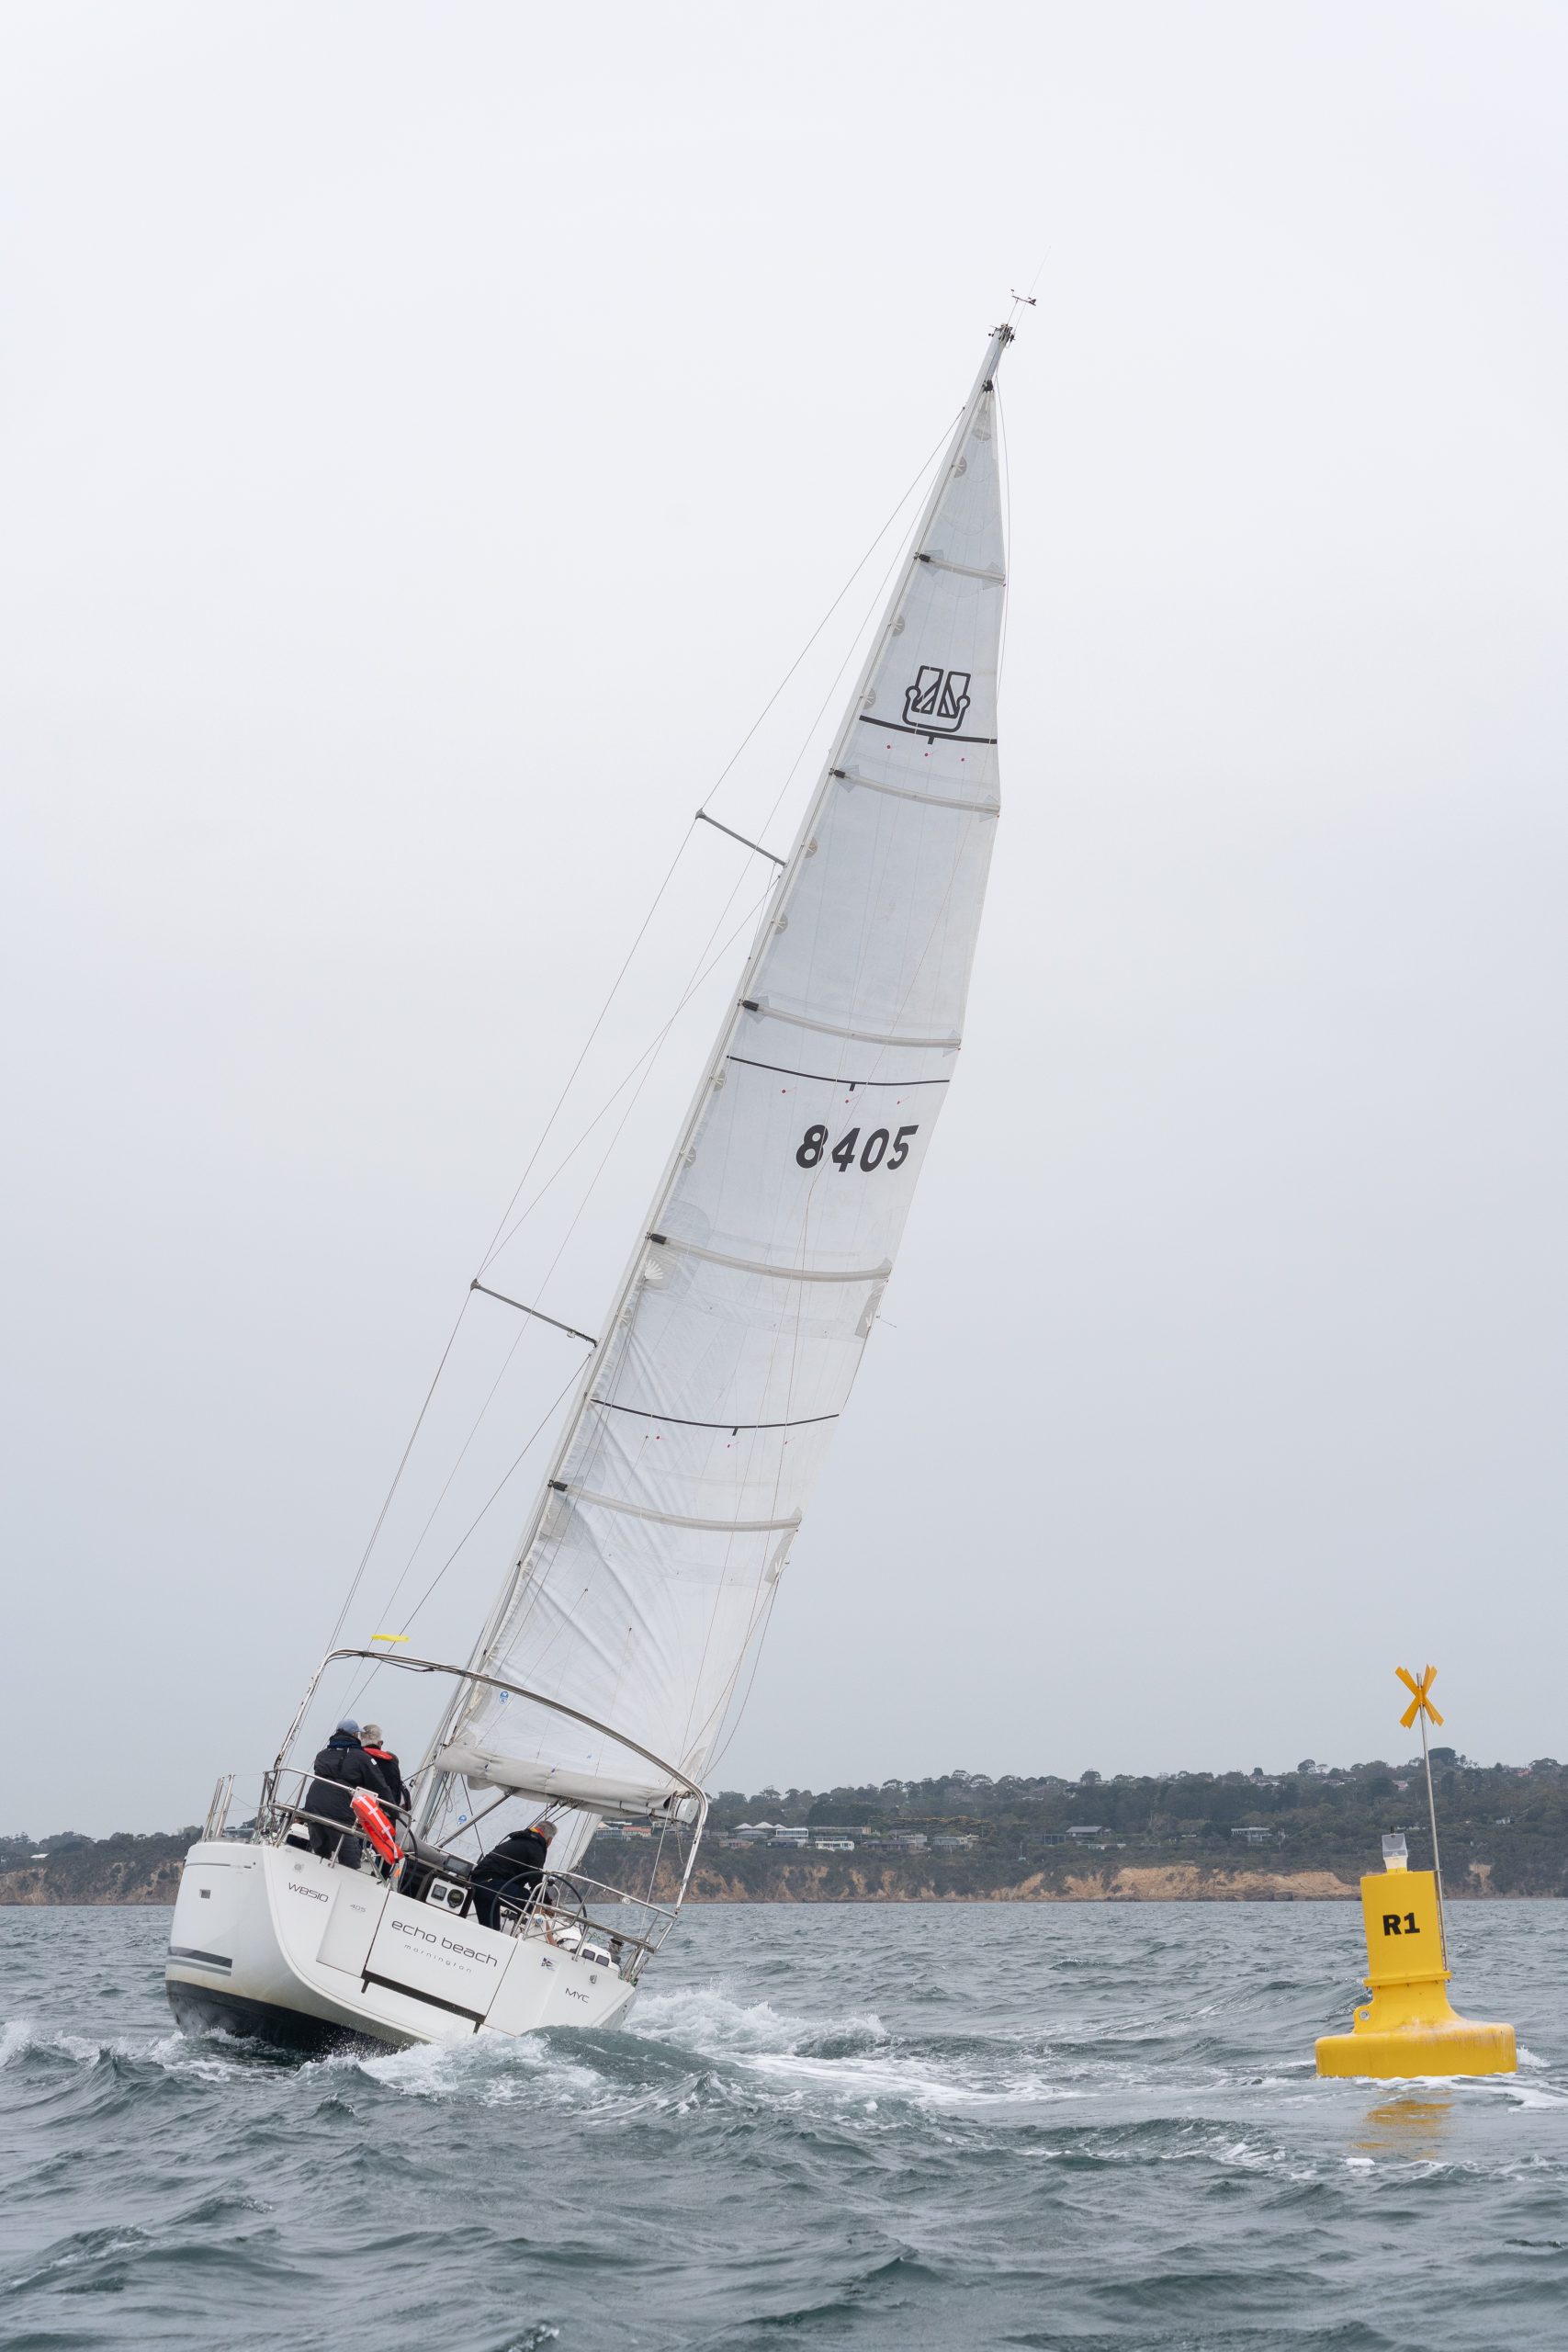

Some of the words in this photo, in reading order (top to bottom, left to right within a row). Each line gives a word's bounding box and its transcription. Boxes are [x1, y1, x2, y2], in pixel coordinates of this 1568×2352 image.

[795, 1124, 919, 1172] 8405
[1382, 1912, 1420, 1936] R1
[391, 1920, 437, 1943] echo
[441, 1937, 498, 1967] beach
[404, 1944, 472, 1973] mornington
[565, 1987, 590, 2003] MYC
